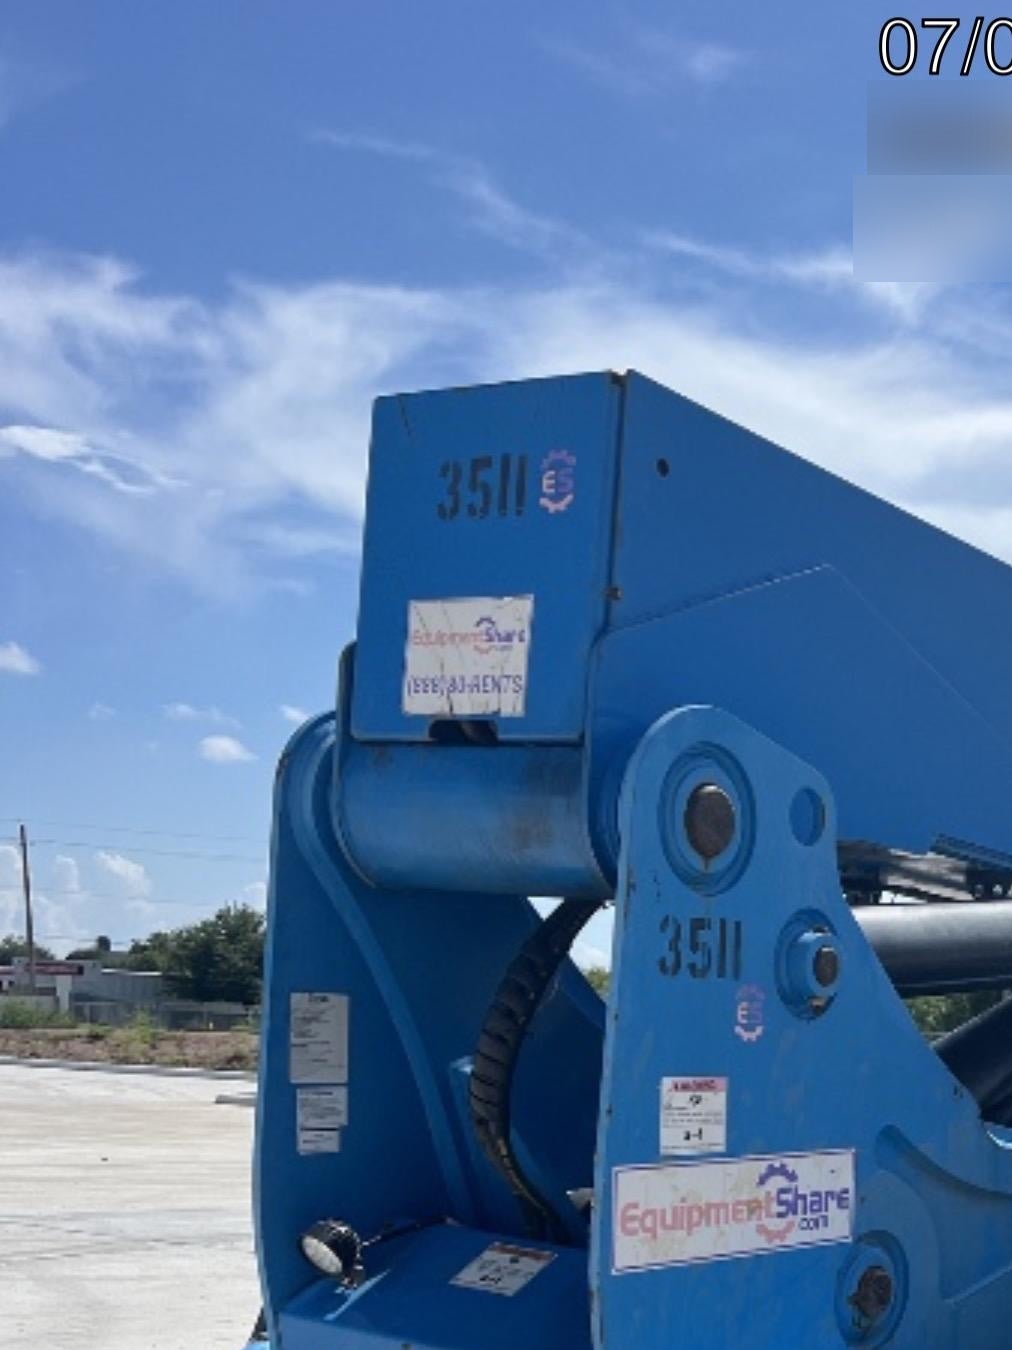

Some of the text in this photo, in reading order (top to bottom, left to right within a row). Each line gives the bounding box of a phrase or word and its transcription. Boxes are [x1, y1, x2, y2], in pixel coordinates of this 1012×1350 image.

[437, 453, 528, 520] 3511
[658, 914, 743, 981] 3511
[619, 1186, 850, 1240] EquipmentShare
